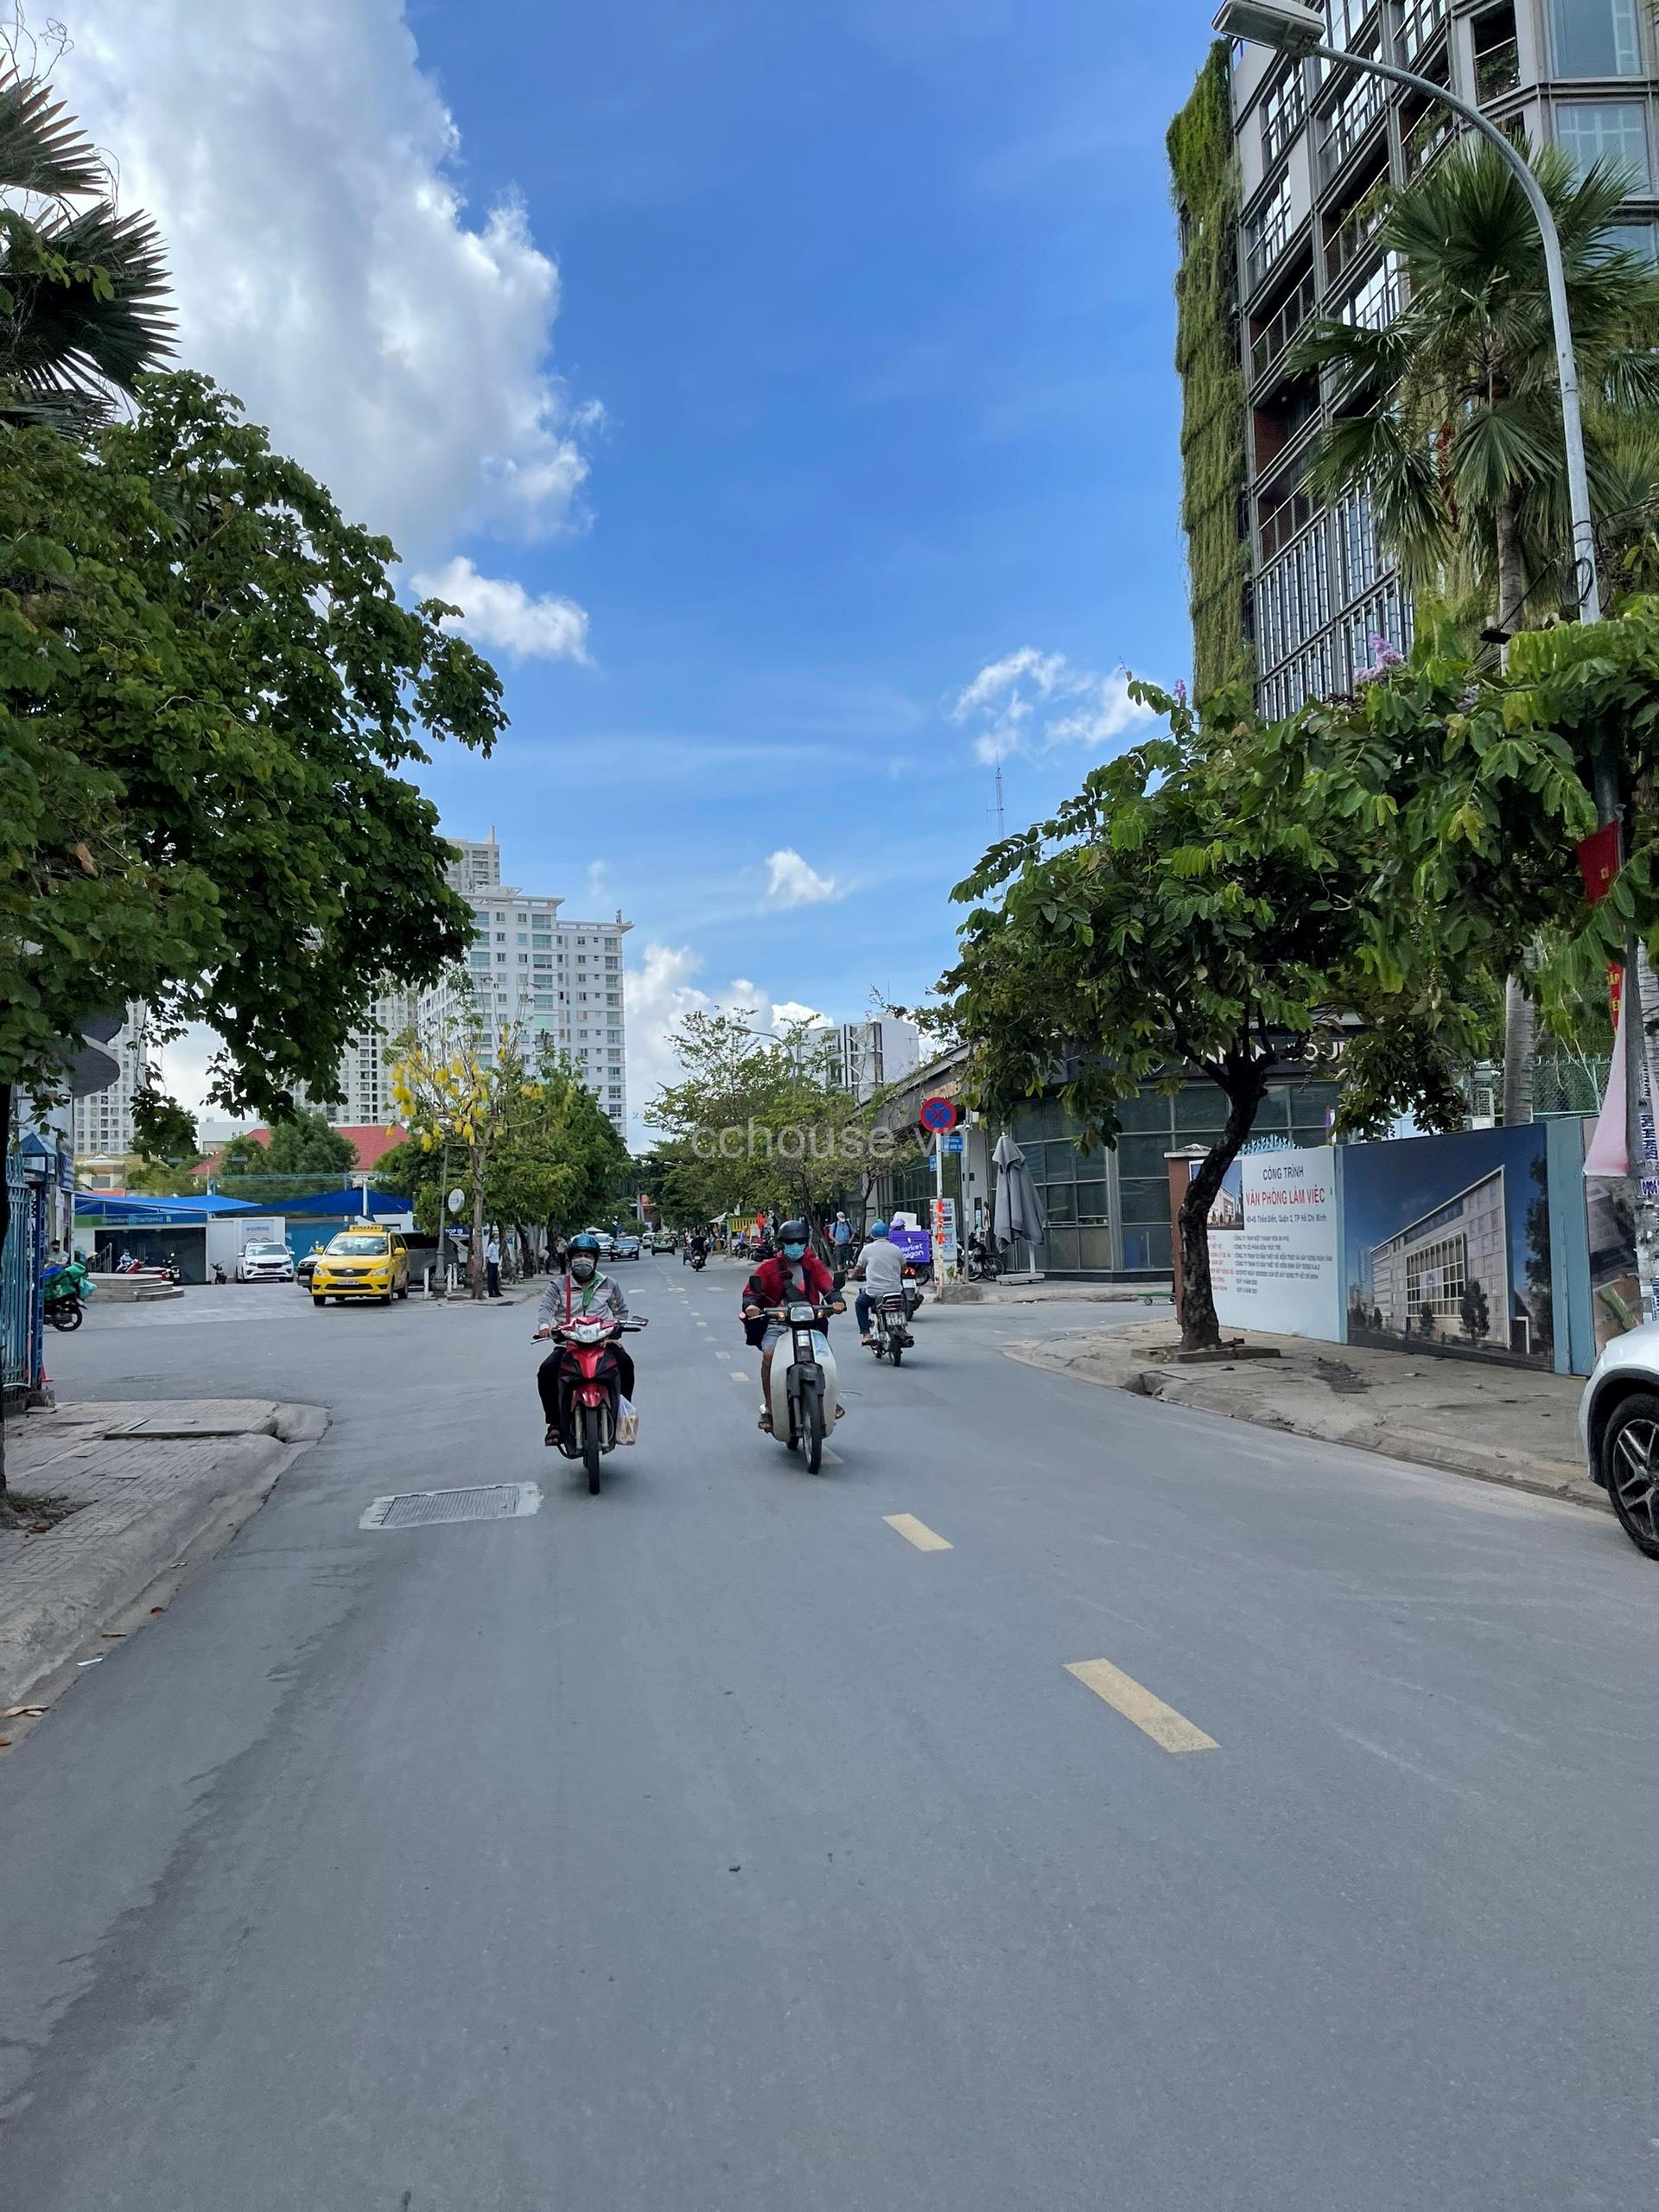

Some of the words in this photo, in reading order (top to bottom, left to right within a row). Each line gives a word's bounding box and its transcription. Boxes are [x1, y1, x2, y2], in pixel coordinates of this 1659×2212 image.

[1262, 1166, 1281, 1180] CÔNG
[1284, 1164, 1304, 1178] TRÌNH
[1246, 1189, 1260, 1205] VĂN
[1262, 1187, 1287, 1205] PHÒNG
[1289, 1186, 1305, 1205] LÀM
[1306, 1185, 1325, 1206] VIỆC
[903, 1249, 925, 1259] aigon
